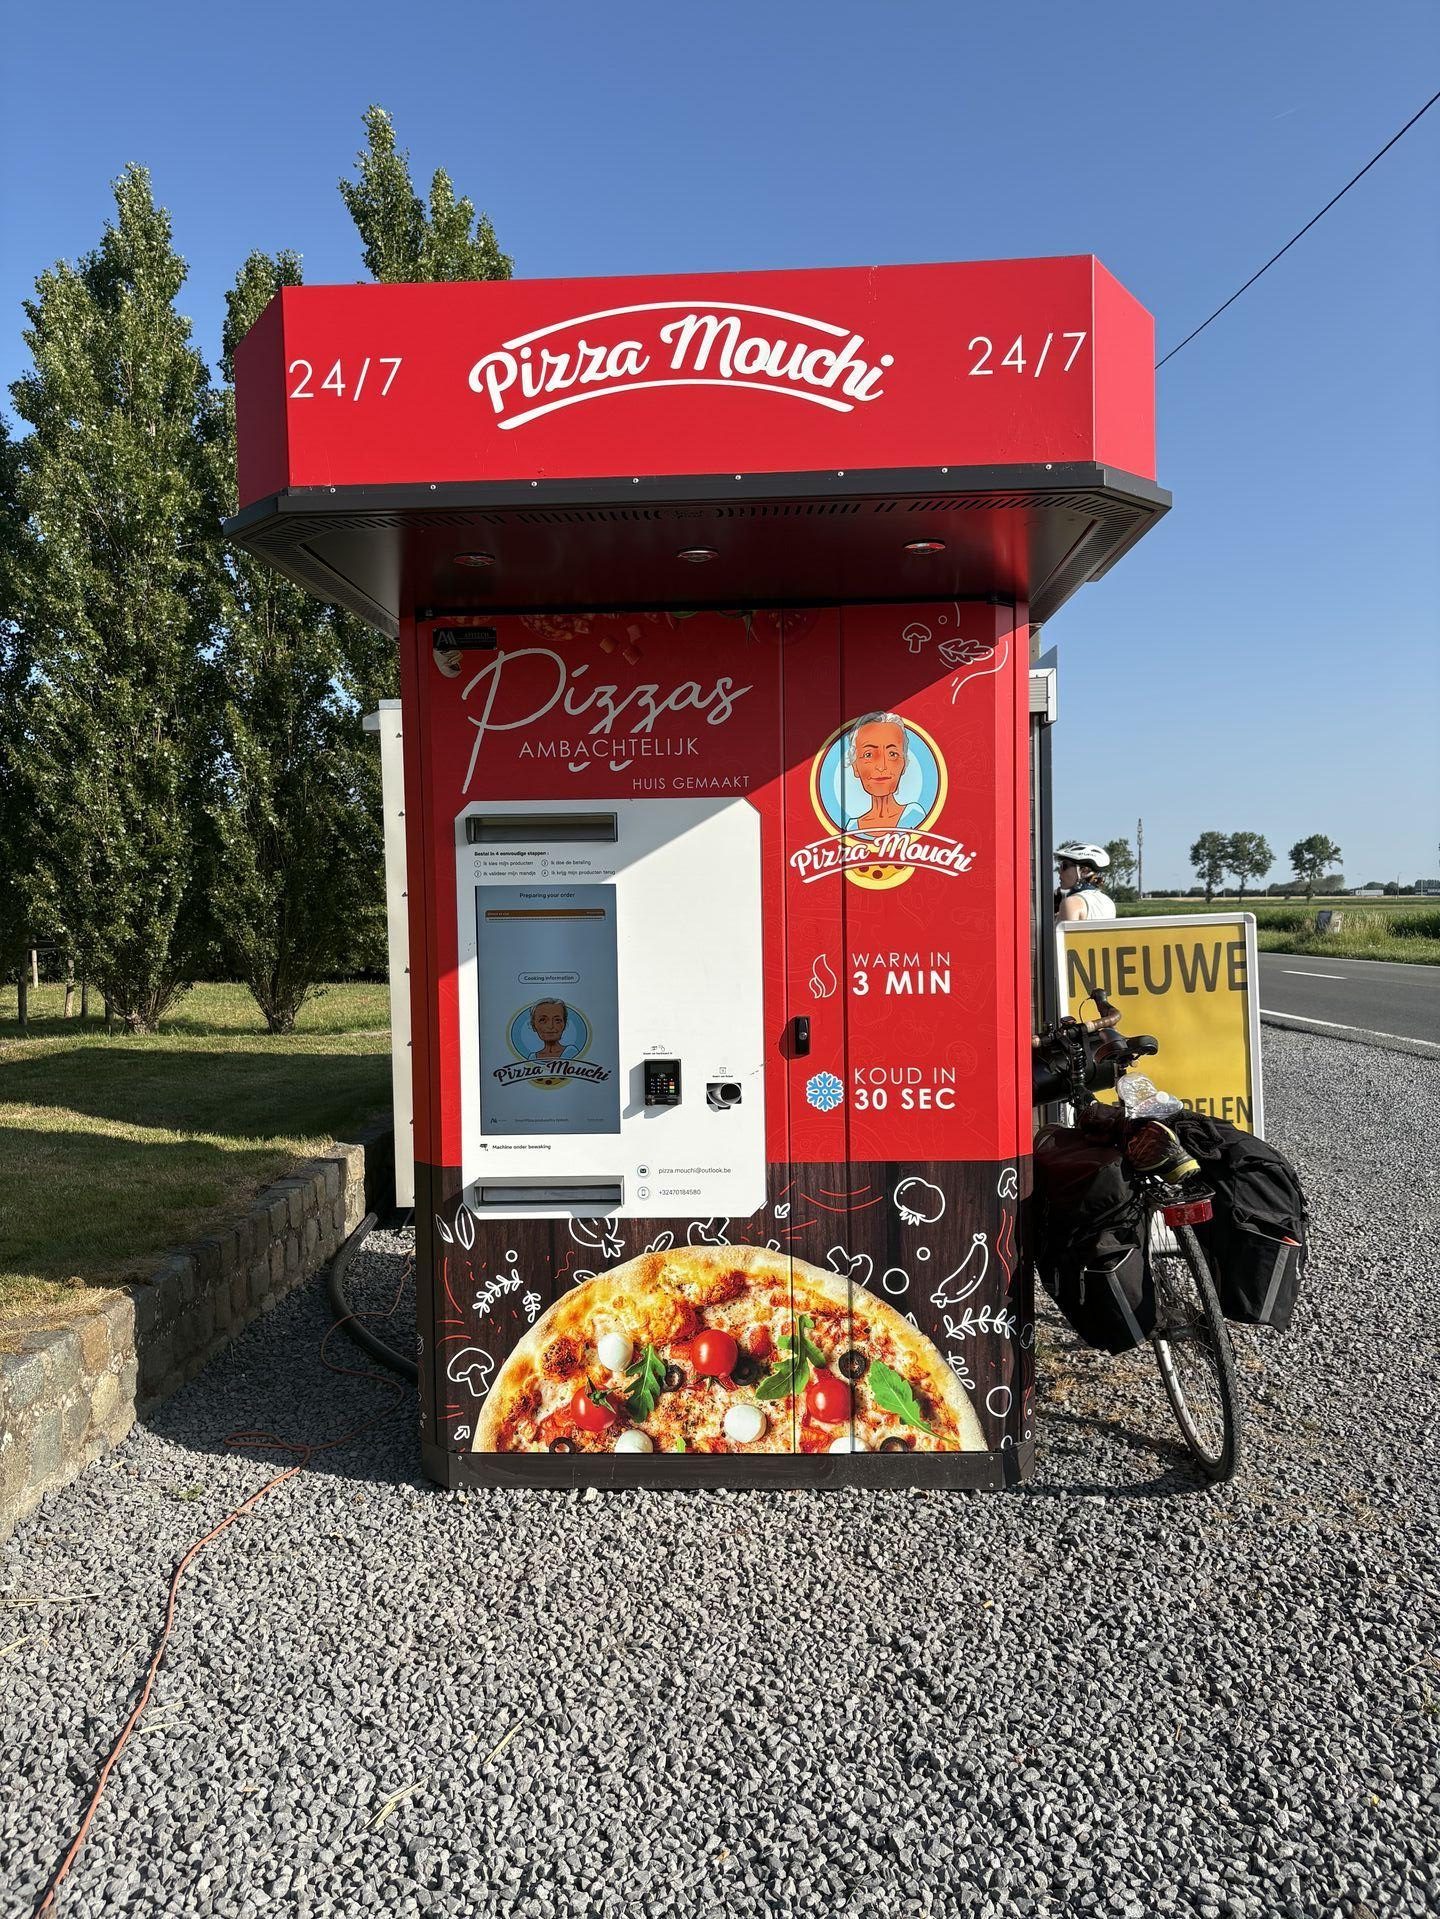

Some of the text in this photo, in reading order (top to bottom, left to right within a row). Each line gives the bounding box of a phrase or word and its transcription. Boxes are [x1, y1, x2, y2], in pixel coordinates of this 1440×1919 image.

[468, 314, 895, 414] Pizza Mouchi
[968, 331, 1087, 378] 24/7
[289, 357, 403, 402] 24/7
[461, 648, 753, 795] Pizzas
[518, 737, 699, 758] AMBACHTELIJK
[632, 776, 750, 790] HUIS GEMAAKT
[790, 832, 977, 877] Pizza Mouchi
[852, 952, 951, 967] WARM IN
[1067, 942, 1248, 998] NIEUWE
[852, 970, 951, 996] 3 MIN
[493, 1060, 612, 1082] Pizza Mouchi
[854, 1067, 956, 1085] KOUD IN
[854, 1087, 957, 1110] 30 SEC
[658, 1167, 732, 1175] pizza.mouchi@outlook.be
